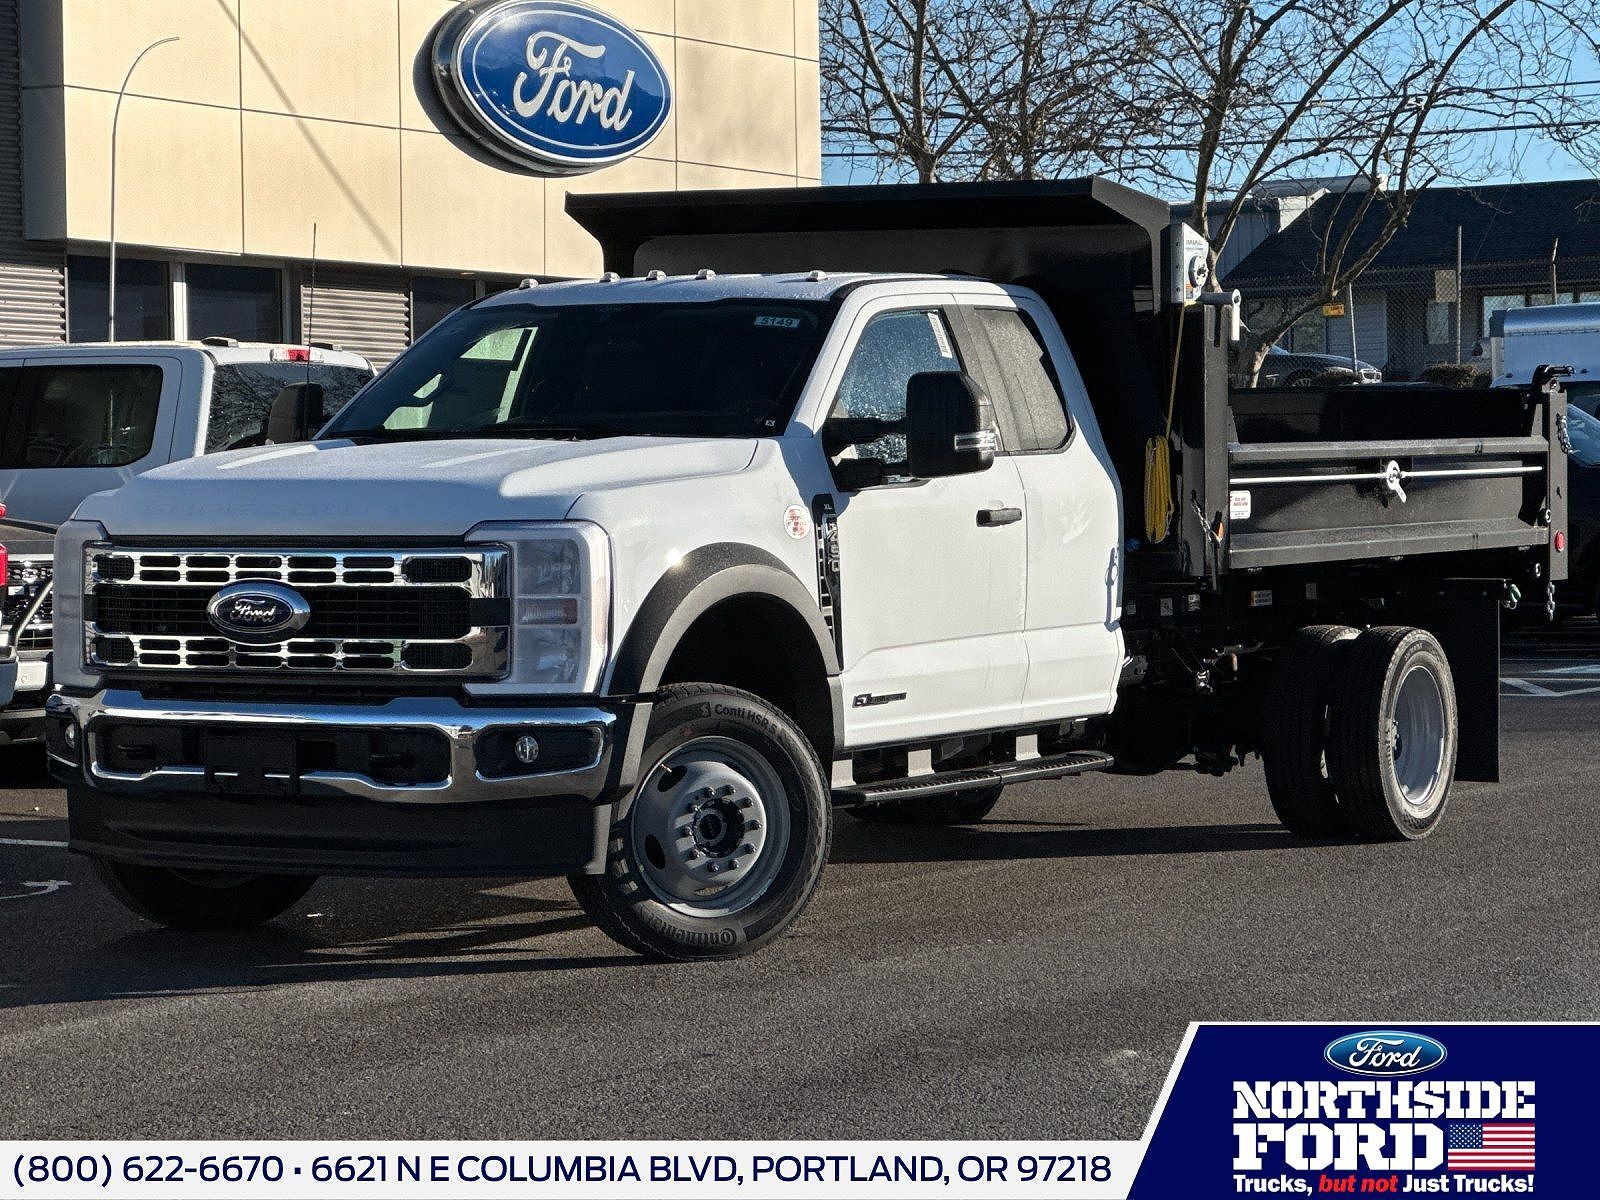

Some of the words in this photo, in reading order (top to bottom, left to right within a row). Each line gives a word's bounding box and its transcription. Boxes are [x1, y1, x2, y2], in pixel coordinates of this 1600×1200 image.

[513, 31, 635, 131] Ford
[230, 598, 277, 622] Ford
[714, 703, 746, 719] Conti
